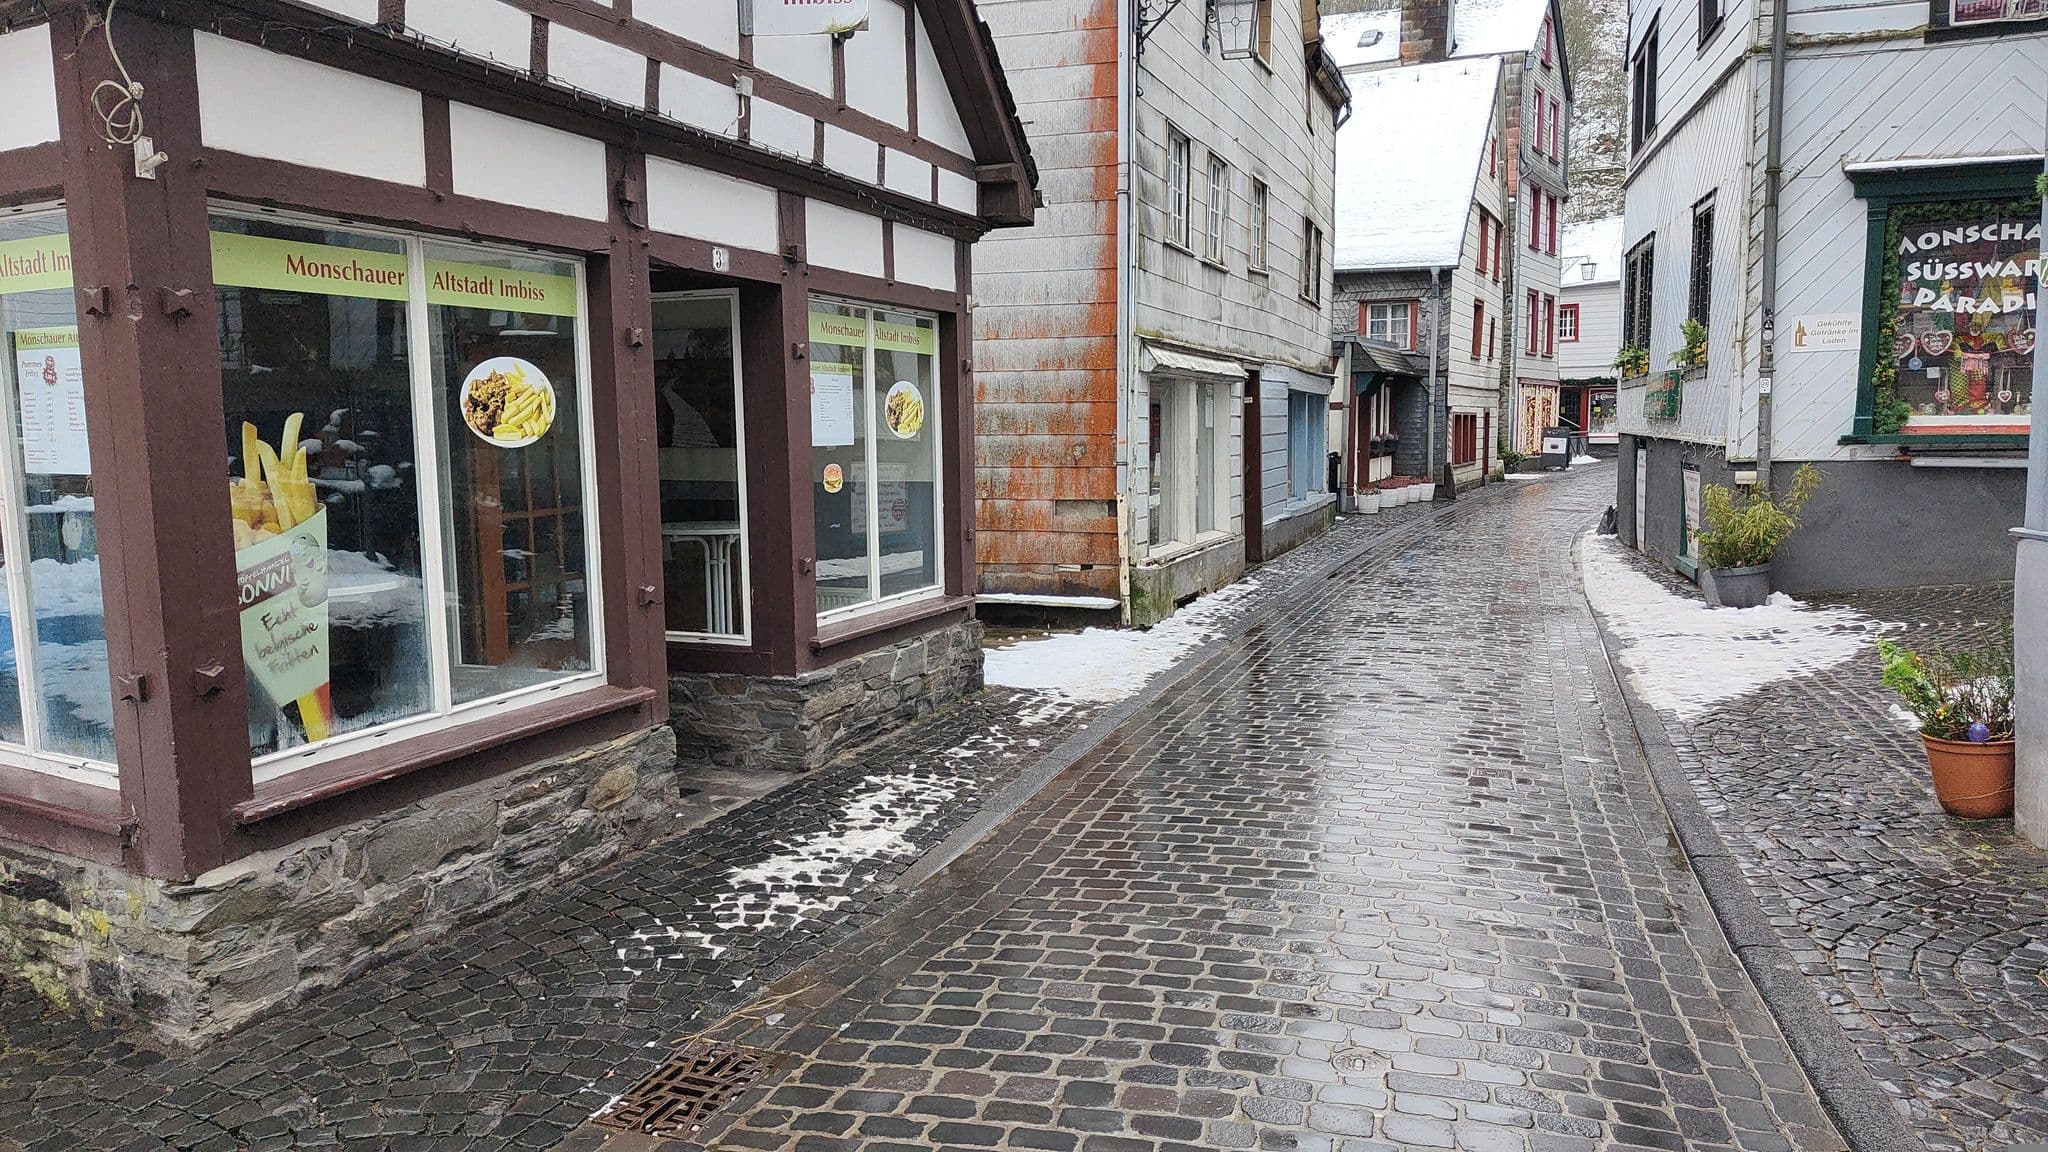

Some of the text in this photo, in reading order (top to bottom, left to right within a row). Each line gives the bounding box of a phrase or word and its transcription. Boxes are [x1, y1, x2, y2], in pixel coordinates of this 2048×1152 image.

[286, 254, 545, 301] Monschauer Altstadt Imbiss
[1913, 287, 2036, 314] PARADI
[20, 331, 65, 345] Monschauer
[820, 321, 920, 345] Monschauer Altstadt Imbiss
[237, 555, 291, 584] OFFELHANDEL
[260, 601, 298, 631] Echt
[255, 622, 319, 659] belgische
